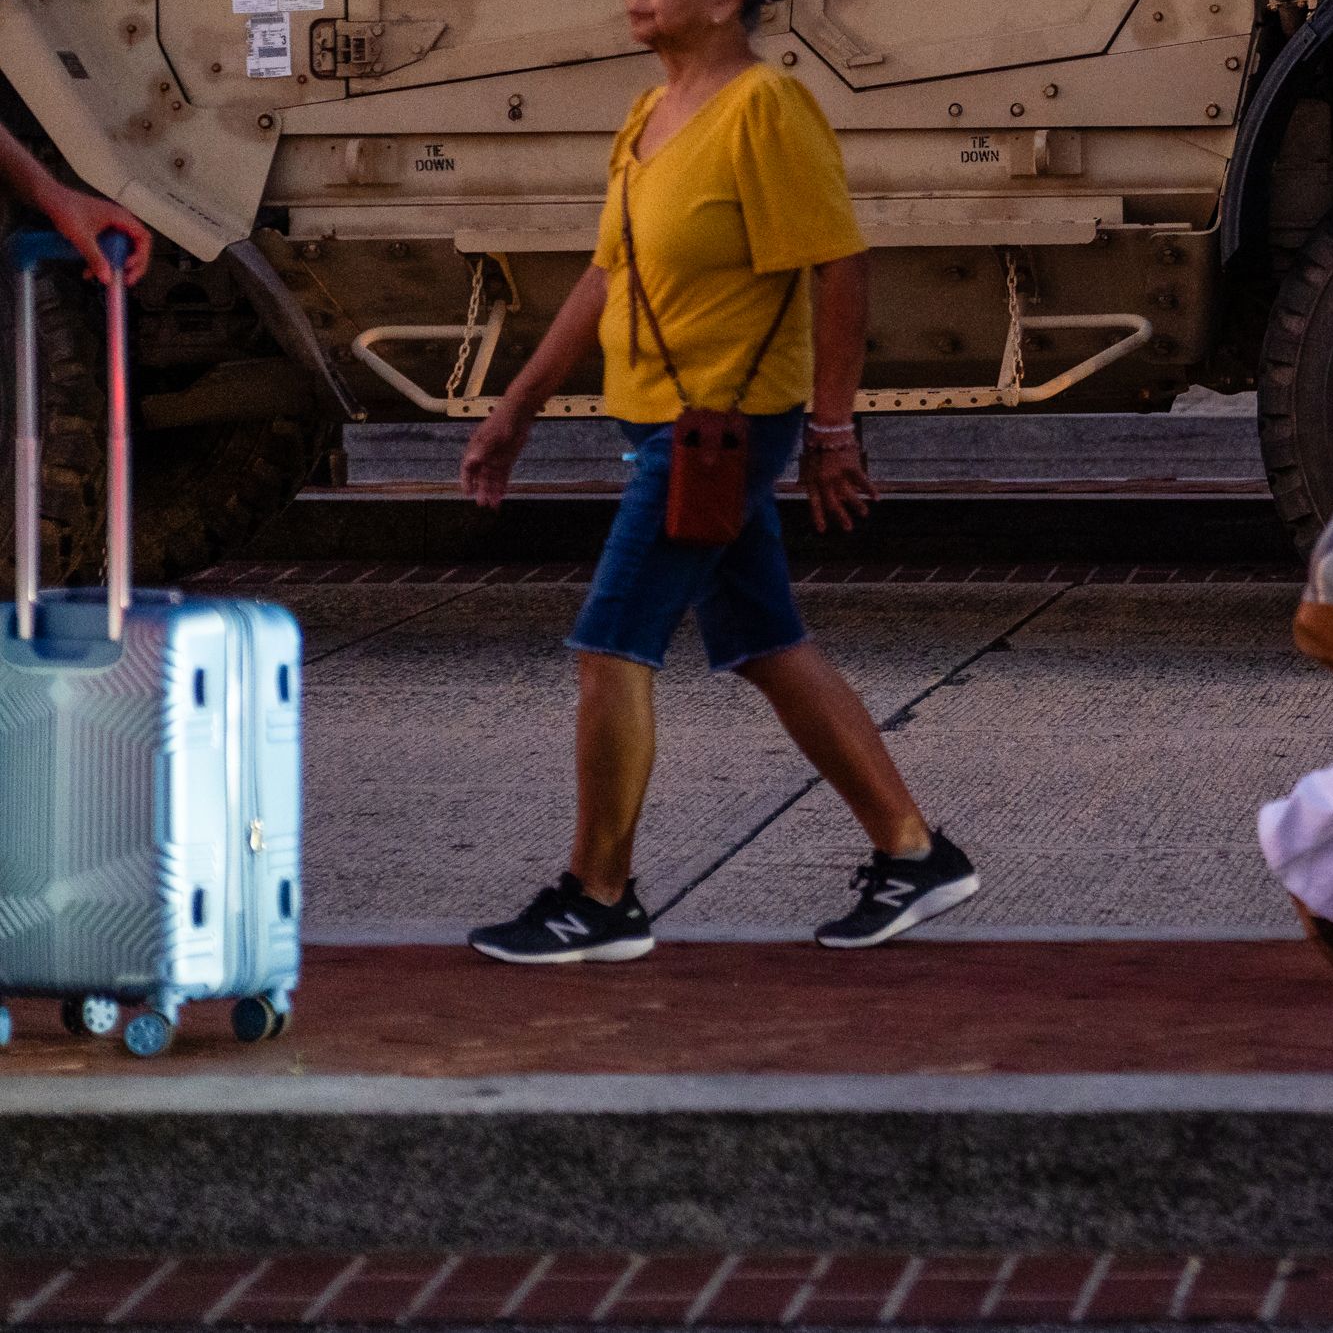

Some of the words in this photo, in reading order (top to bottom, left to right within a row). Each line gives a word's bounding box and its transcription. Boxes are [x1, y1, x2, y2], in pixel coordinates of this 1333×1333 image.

[970, 136, 990, 149] TIE
[424, 144, 444, 157] TIE
[960, 150, 1000, 164] DOWN
[415, 158, 455, 172] DOWN
